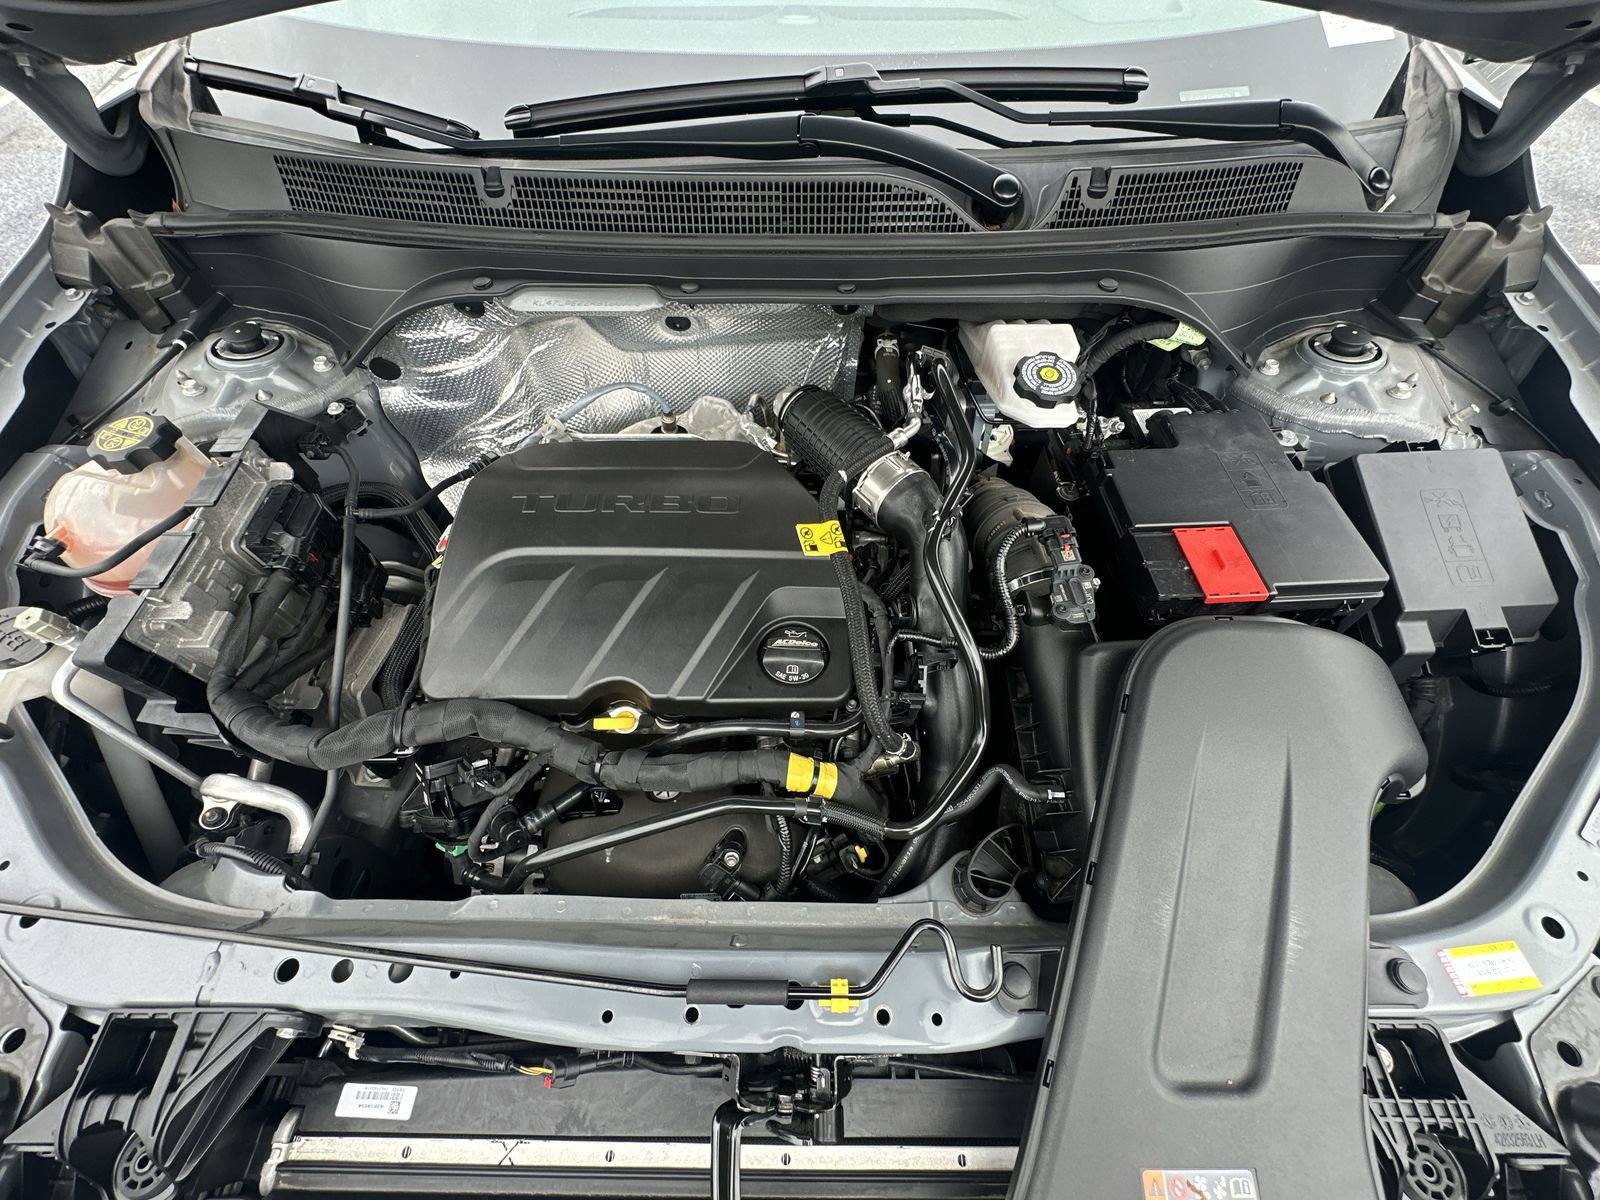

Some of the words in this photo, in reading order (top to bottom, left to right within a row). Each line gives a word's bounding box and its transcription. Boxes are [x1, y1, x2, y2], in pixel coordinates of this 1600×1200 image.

[511, 493, 741, 514] TURBO
[771, 639, 819, 648] ACDelco
[775, 671, 787, 680] SAE
[788, 672, 809, 681] 5W-30
